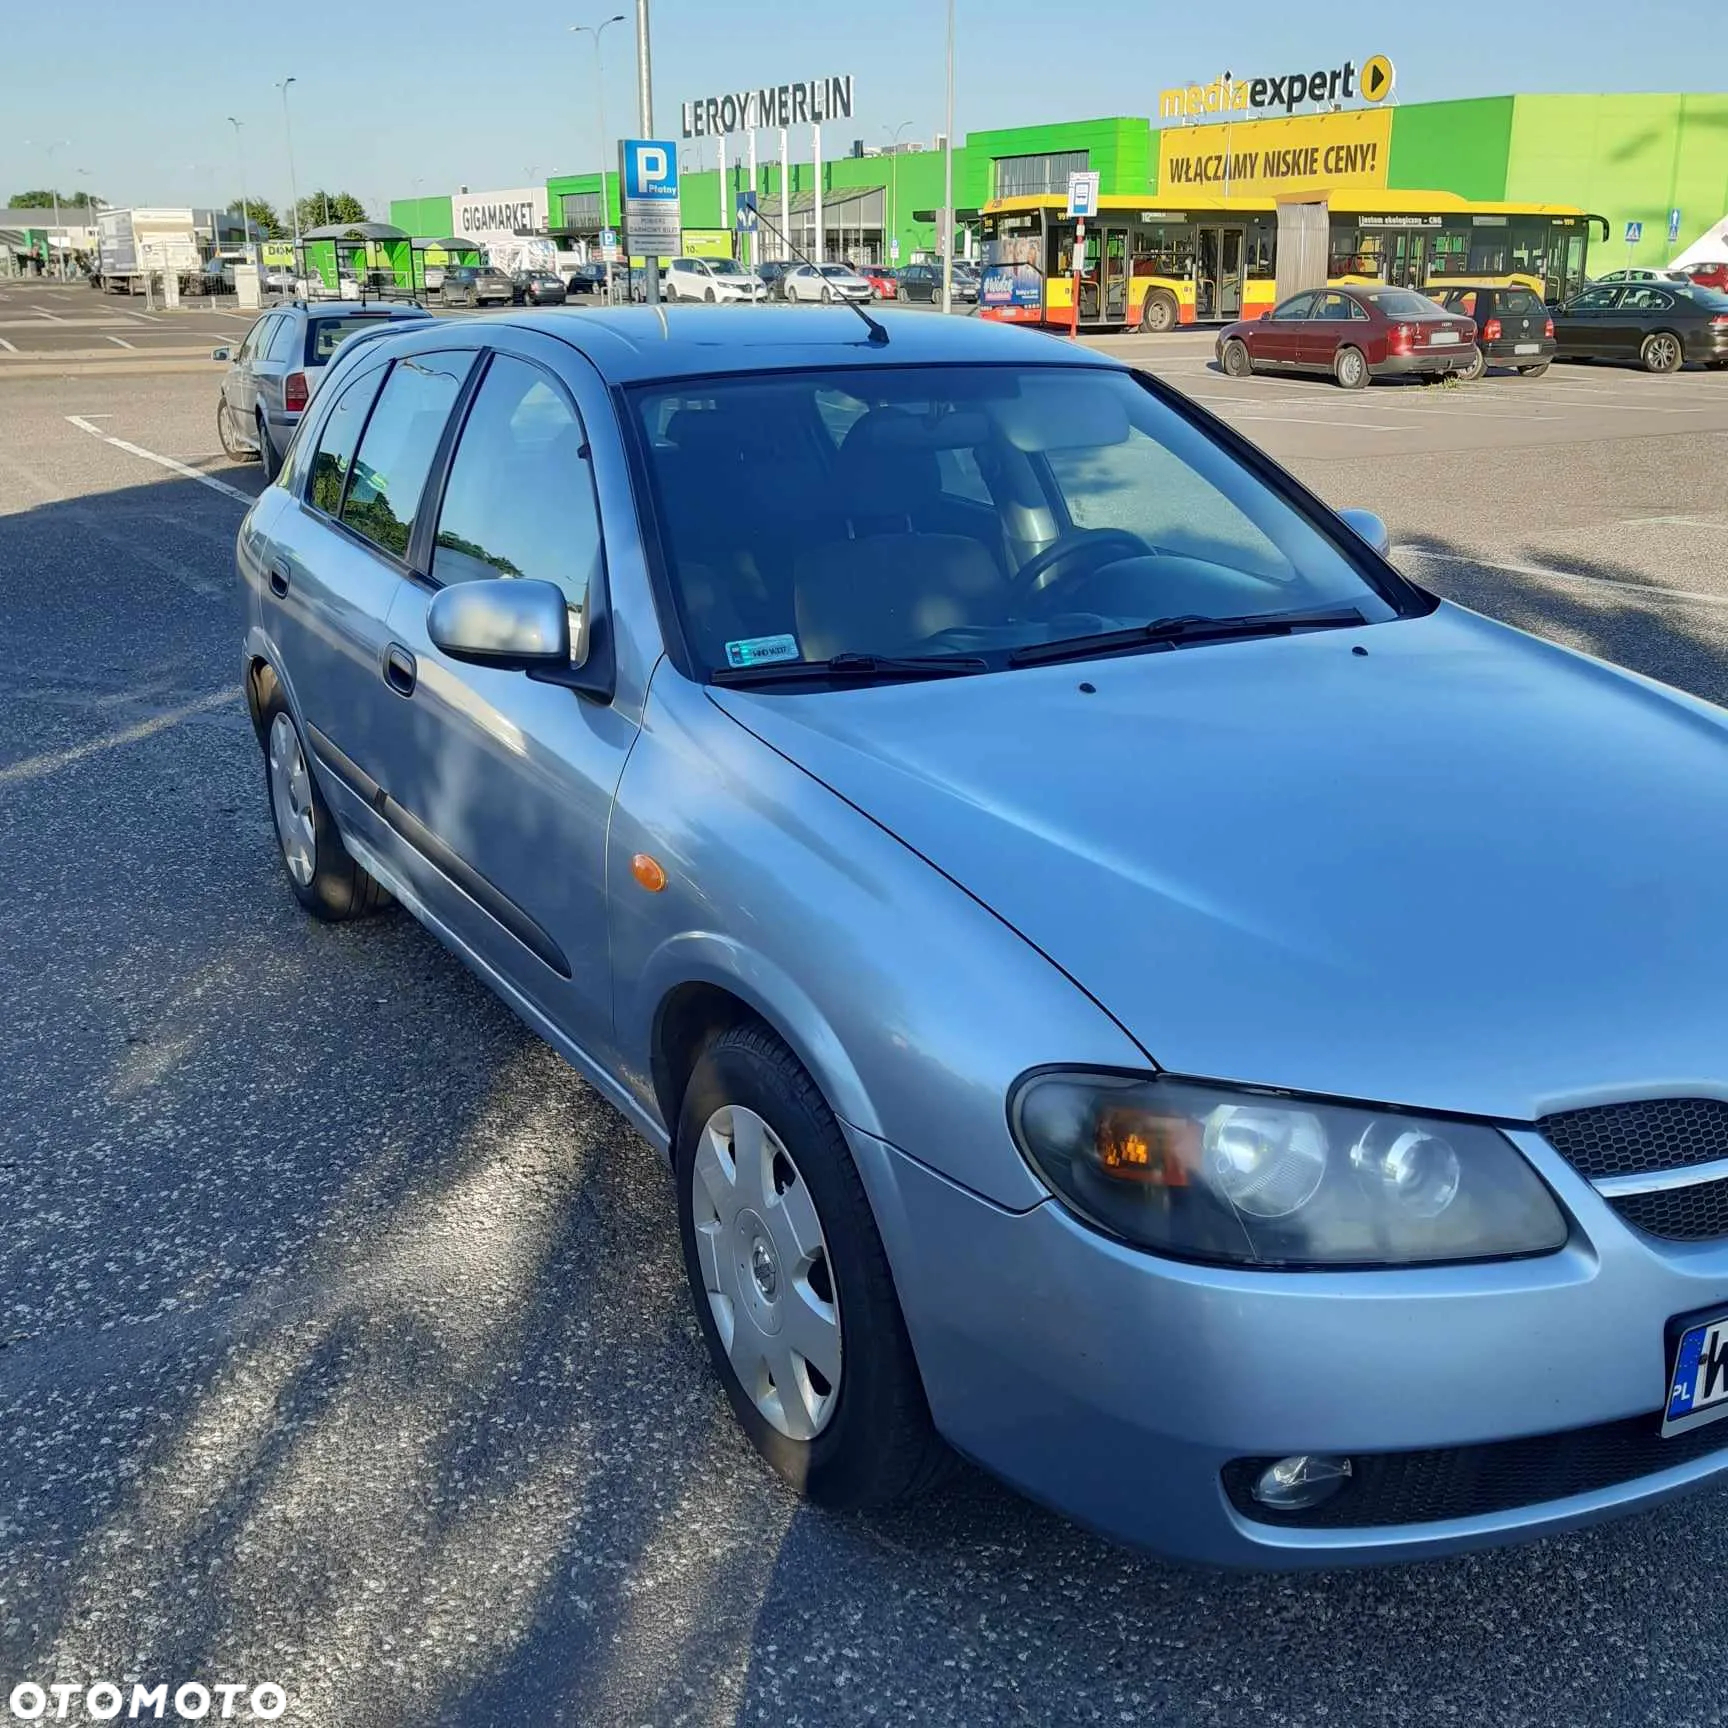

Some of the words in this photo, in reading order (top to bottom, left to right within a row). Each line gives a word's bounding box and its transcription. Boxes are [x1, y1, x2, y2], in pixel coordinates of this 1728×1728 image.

[682, 92, 750, 138] LEROY
[759, 76, 852, 128] MERLIN
[636, 147, 667, 192] P
[1169, 152, 1259, 185] WŁĄCZAMY
[1263, 147, 1319, 178] NISKIE
[1323, 143, 1377, 174] CENY!
[462, 202, 533, 232] GIGAMARKET
[1673, 1382, 1690, 1401] PL
